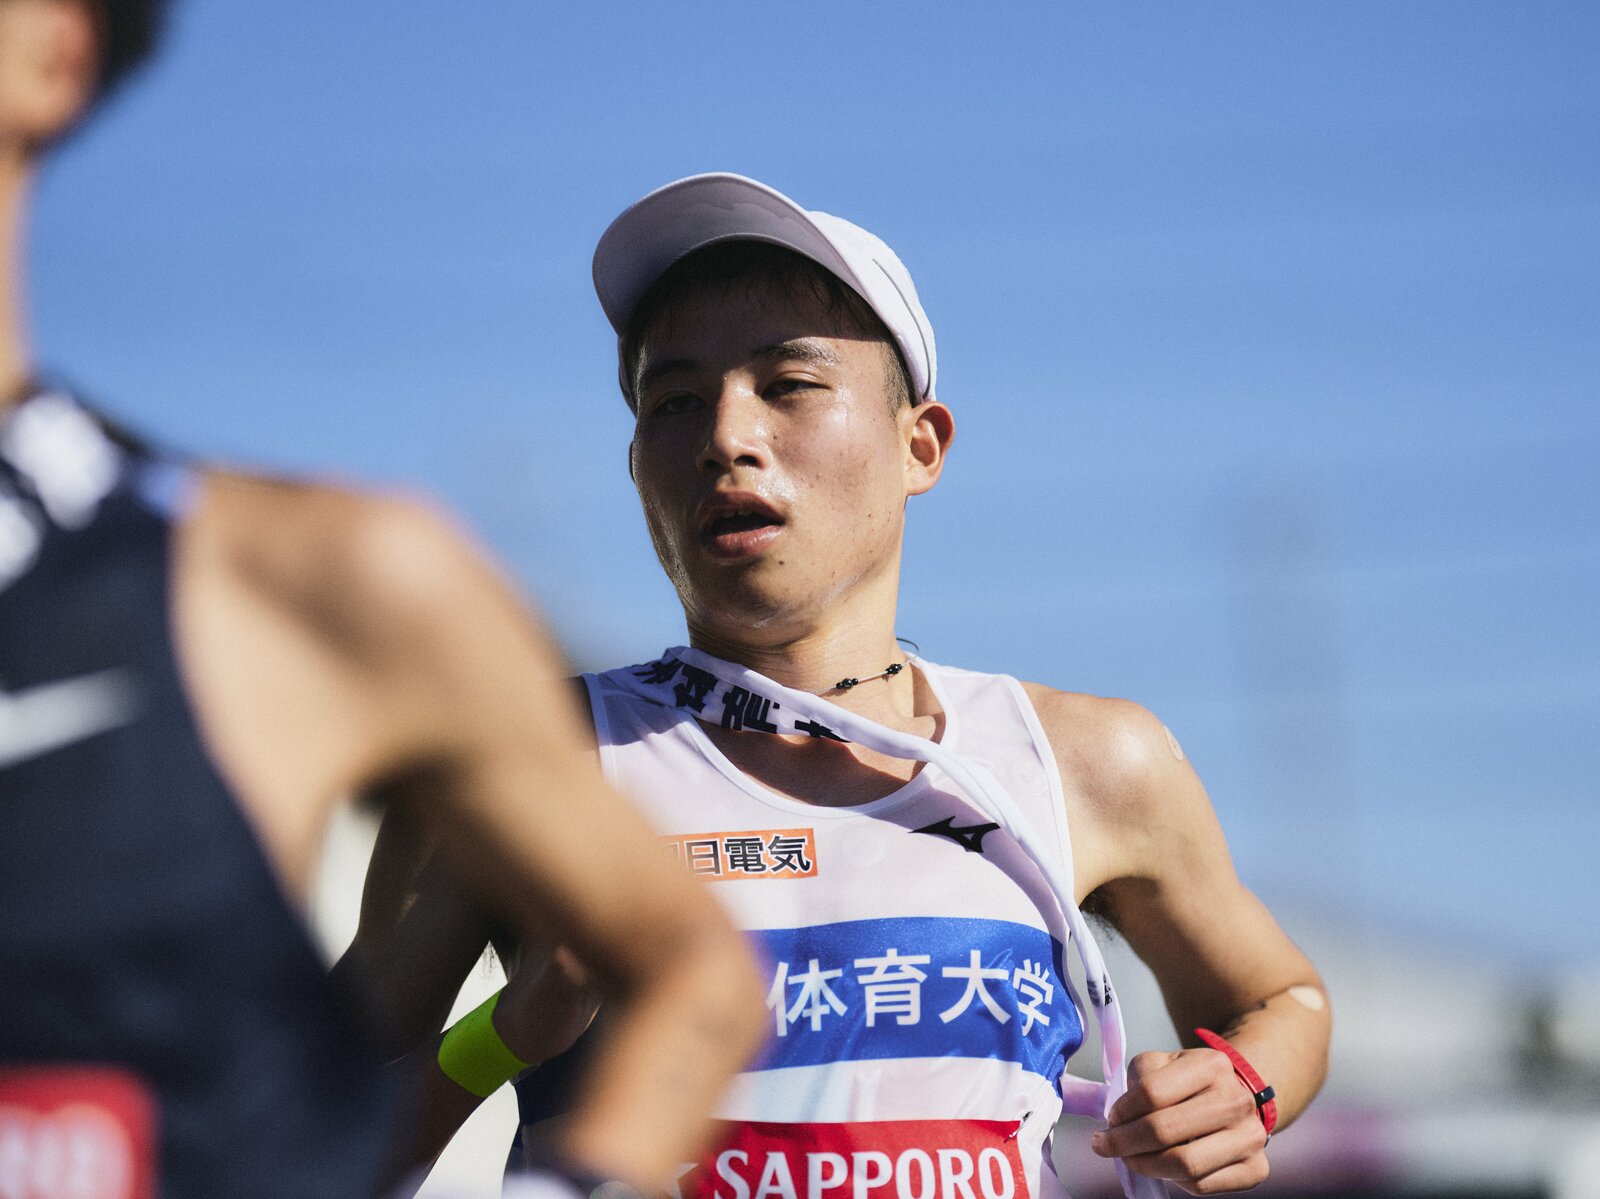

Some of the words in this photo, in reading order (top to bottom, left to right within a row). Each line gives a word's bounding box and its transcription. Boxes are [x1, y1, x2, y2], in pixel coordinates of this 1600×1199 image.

[664, 835, 811, 877] 日電気
[766, 948, 1055, 1038] 体育大学
[712, 1147, 1015, 1199] SAPPORO
